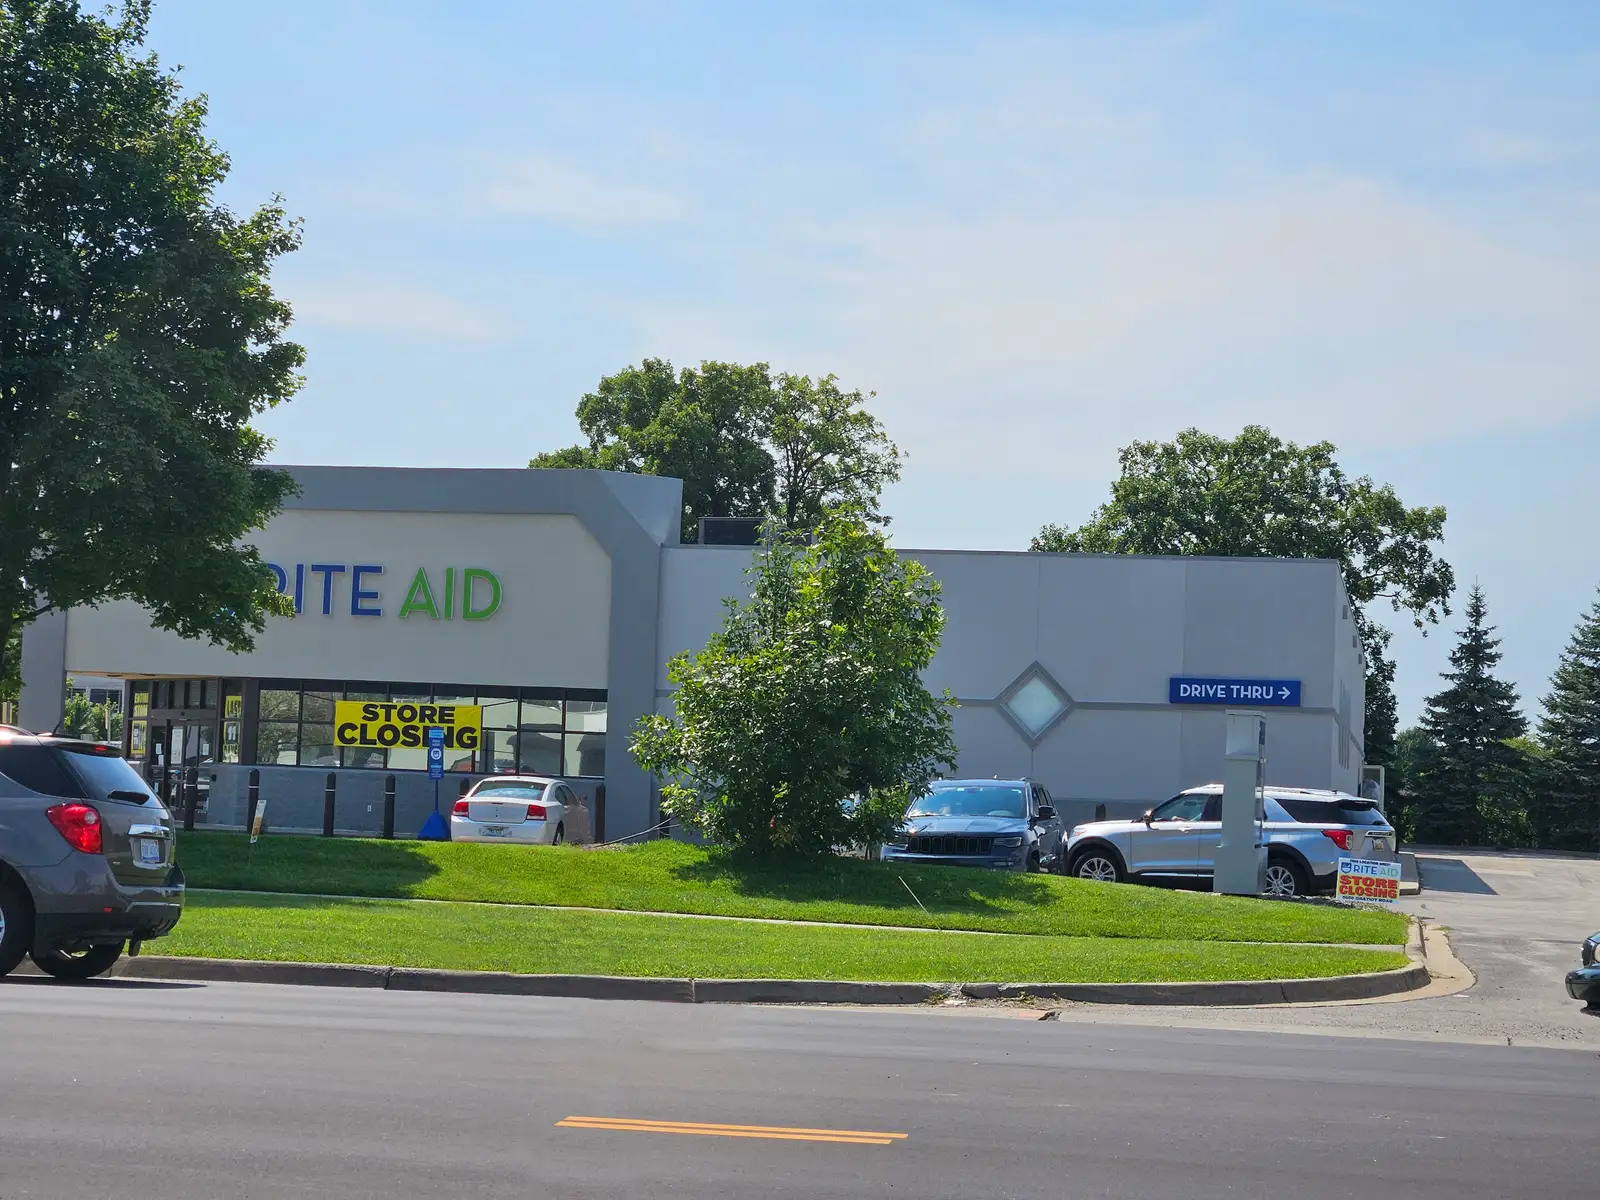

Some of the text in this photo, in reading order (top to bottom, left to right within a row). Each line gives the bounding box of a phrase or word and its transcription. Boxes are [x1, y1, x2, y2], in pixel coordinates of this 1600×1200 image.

[399, 566, 503, 621] AID
[1180, 684, 1274, 699] DRIVE THRU
[361, 703, 456, 724] STORE
[337, 722, 478, 750] CLOSING
[1354, 864, 1398, 877] RITE AID
[1340, 875, 1398, 889] STORE
[1339, 885, 1397, 898] CLOSING
